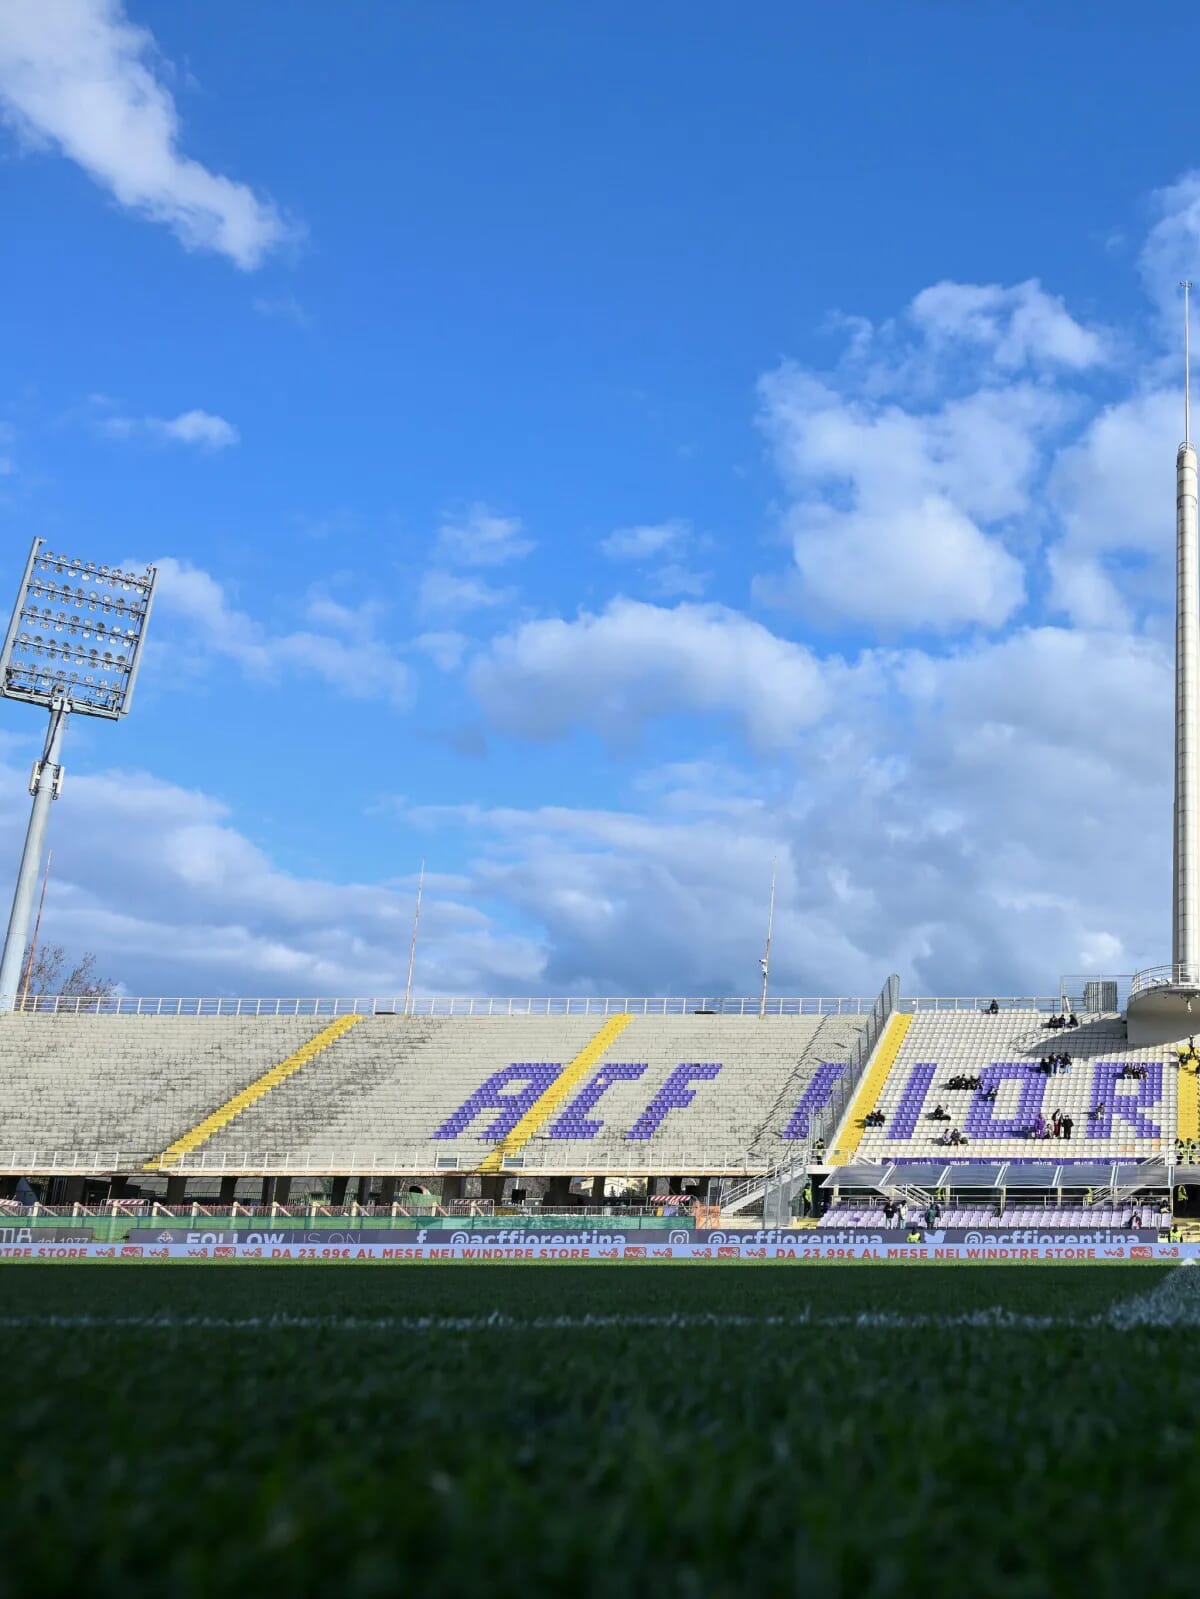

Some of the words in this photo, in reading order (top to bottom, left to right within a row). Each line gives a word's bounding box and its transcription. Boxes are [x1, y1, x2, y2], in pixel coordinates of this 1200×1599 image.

[432, 1063, 723, 1139] ACF
[186, 1232, 285, 1244] FOLLOW
[327, 1232, 361, 1244] ON
[450, 1230, 626, 1244] @acffiorentina
[708, 1230, 883, 1244] @acffiorentina
[964, 1230, 1139, 1244] @acffiorentina
[0, 1248, 32, 1257] TRE
[38, 1248, 87, 1257] STORE
[271, 1248, 292, 1258] DA
[299, 1248, 350, 1258] 23.99€
[357, 1248, 374, 1258] AL
[382, 1248, 423, 1258] MESE
[429, 1248, 454, 1258] NEI
[461, 1248, 533, 1258] WINDTRE
[540, 1248, 589, 1258] STORE
[776, 1248, 796, 1258] DA
[803, 1248, 854, 1258] 23.99€
[862, 1248, 879, 1258] AL
[888, 1248, 928, 1258] MESE
[934, 1248, 960, 1258] NEI
[967, 1248, 1039, 1258] WINDTRE
[1046, 1248, 1095, 1258] STORE
